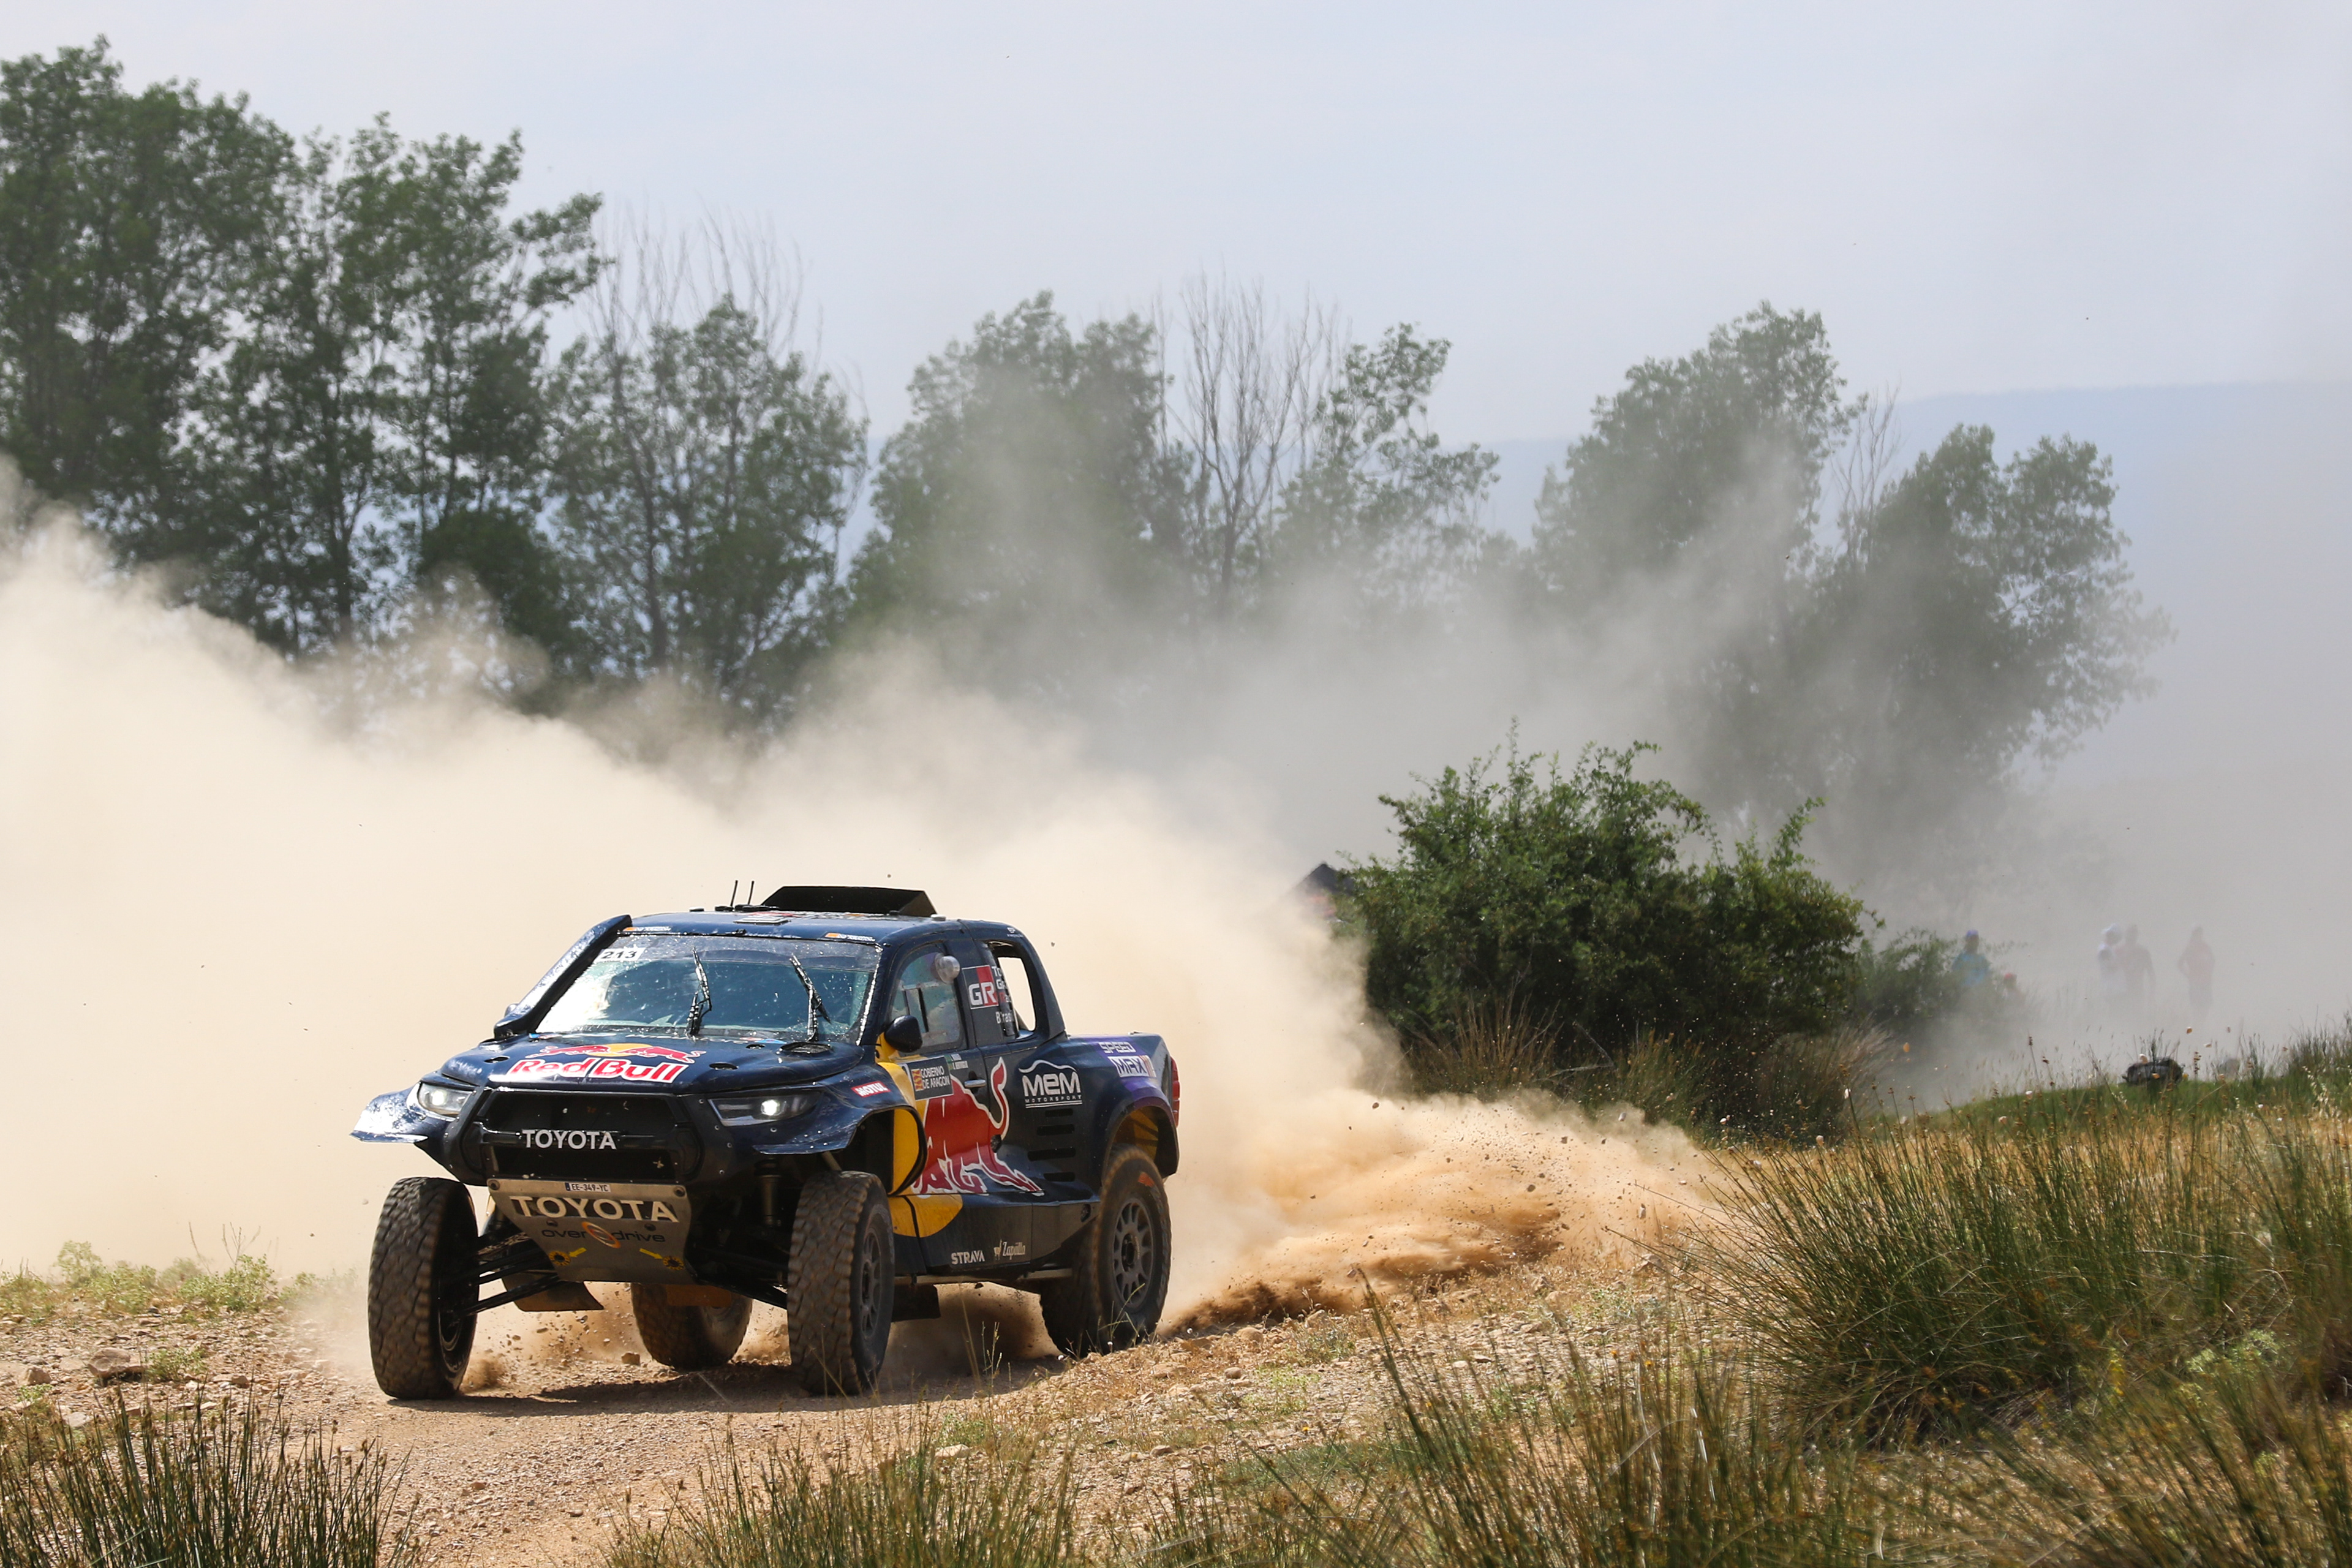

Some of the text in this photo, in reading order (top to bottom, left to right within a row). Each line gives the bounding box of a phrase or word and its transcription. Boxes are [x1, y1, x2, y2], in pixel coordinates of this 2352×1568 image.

[601, 951, 638, 959] 213
[968, 982, 997, 1006] GR
[1098, 1042, 1136, 1054] SPEED
[510, 1058, 684, 1082] Red Bull
[921, 1066, 945, 1079] GOBIERNO
[1111, 1058, 1147, 1074] MAX
[855, 1082, 888, 1096] MOTUL
[922, 1079, 930, 1089] DE
[522, 1129, 617, 1150] TOYOTA
[571, 1183, 609, 1192] EE-349-YC
[510, 1196, 679, 1223] TOYOTA
[541, 1228, 666, 1242] over drive
[951, 1250, 985, 1265] STRAVA
